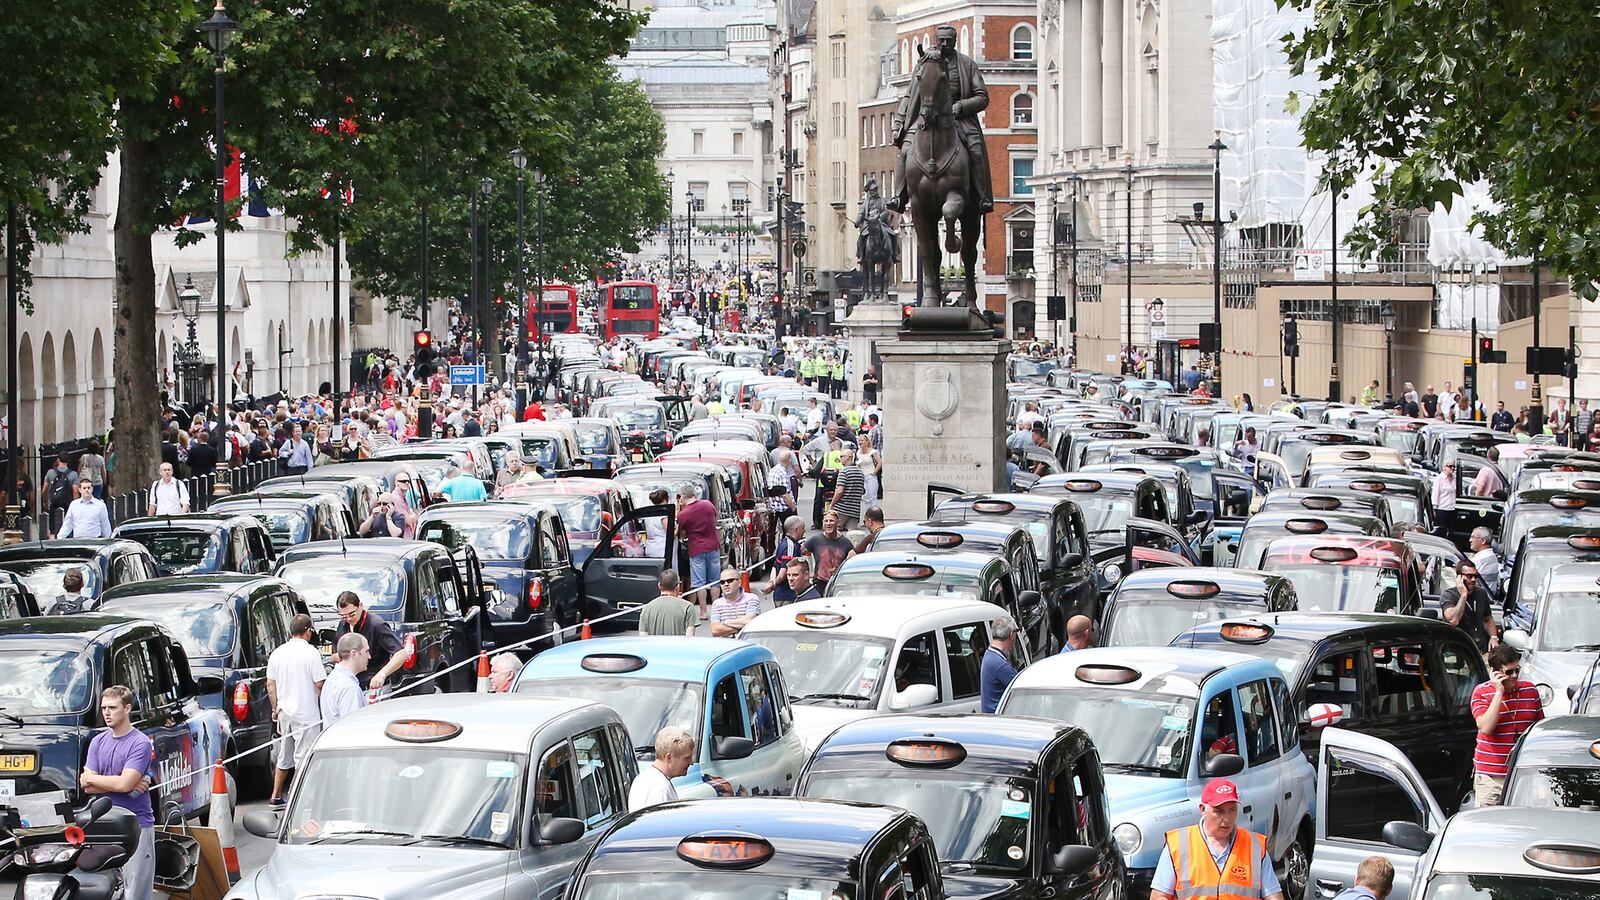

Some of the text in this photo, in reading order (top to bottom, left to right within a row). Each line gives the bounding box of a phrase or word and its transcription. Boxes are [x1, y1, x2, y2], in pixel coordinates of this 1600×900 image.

[628, 301, 638, 309] 29
[902, 453, 973, 463] EARL HAIG
[4, 756, 29, 768] HGT
[158, 752, 192, 798] Matilda
